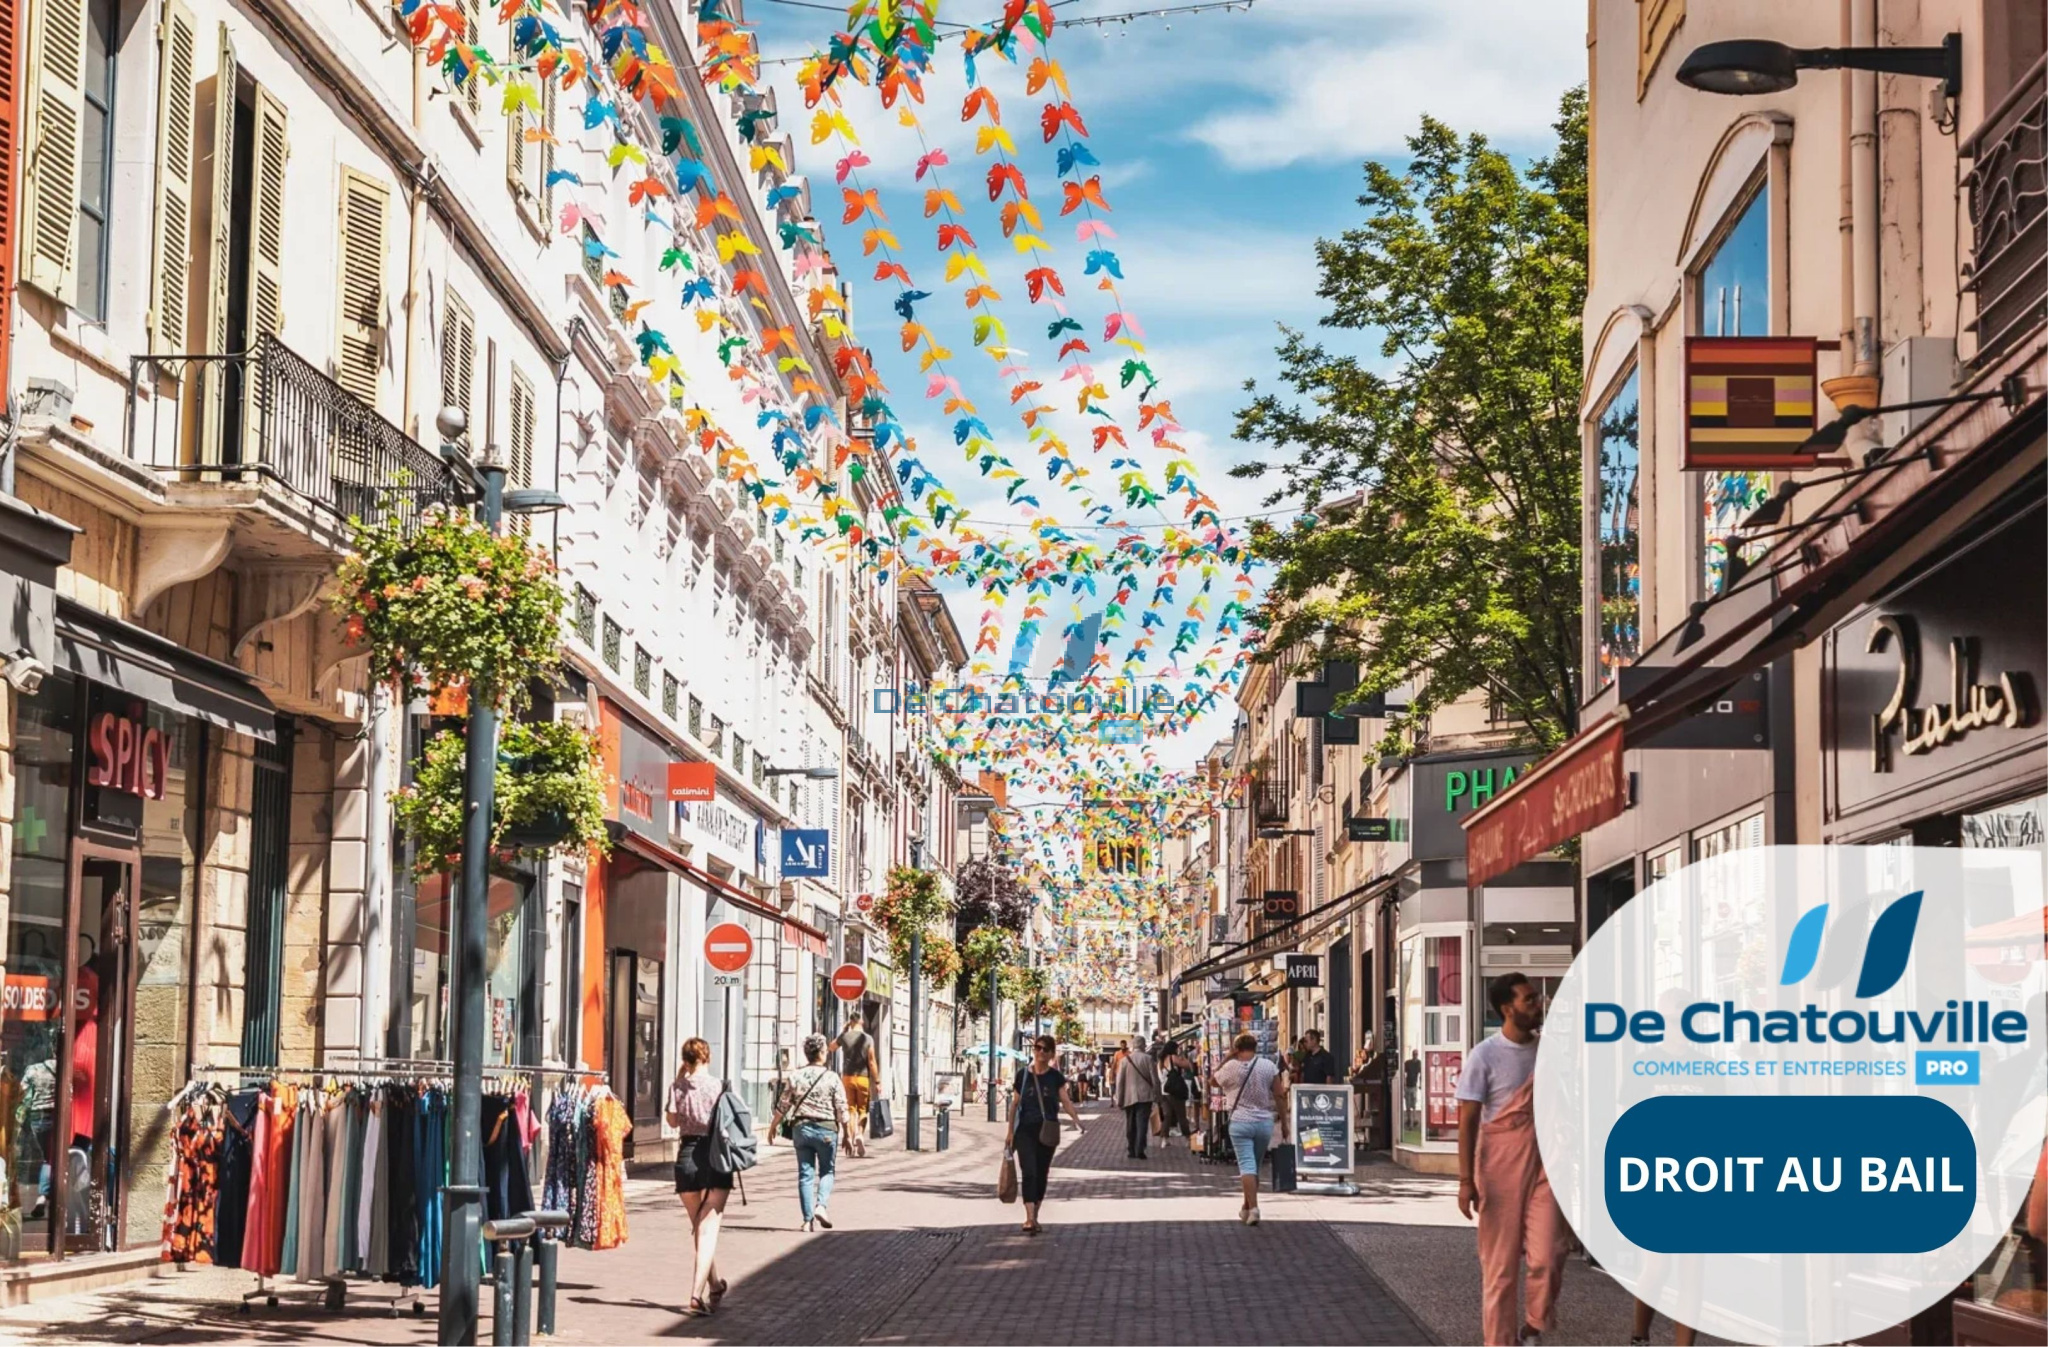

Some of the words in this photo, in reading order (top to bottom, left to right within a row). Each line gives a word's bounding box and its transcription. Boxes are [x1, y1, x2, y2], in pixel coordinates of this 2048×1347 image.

[90, 711, 175, 801] SPICY
[672, 787, 710, 797] catimini
[1288, 964, 1319, 979] APRIL
[3, 985, 47, 1011] SOLDES
